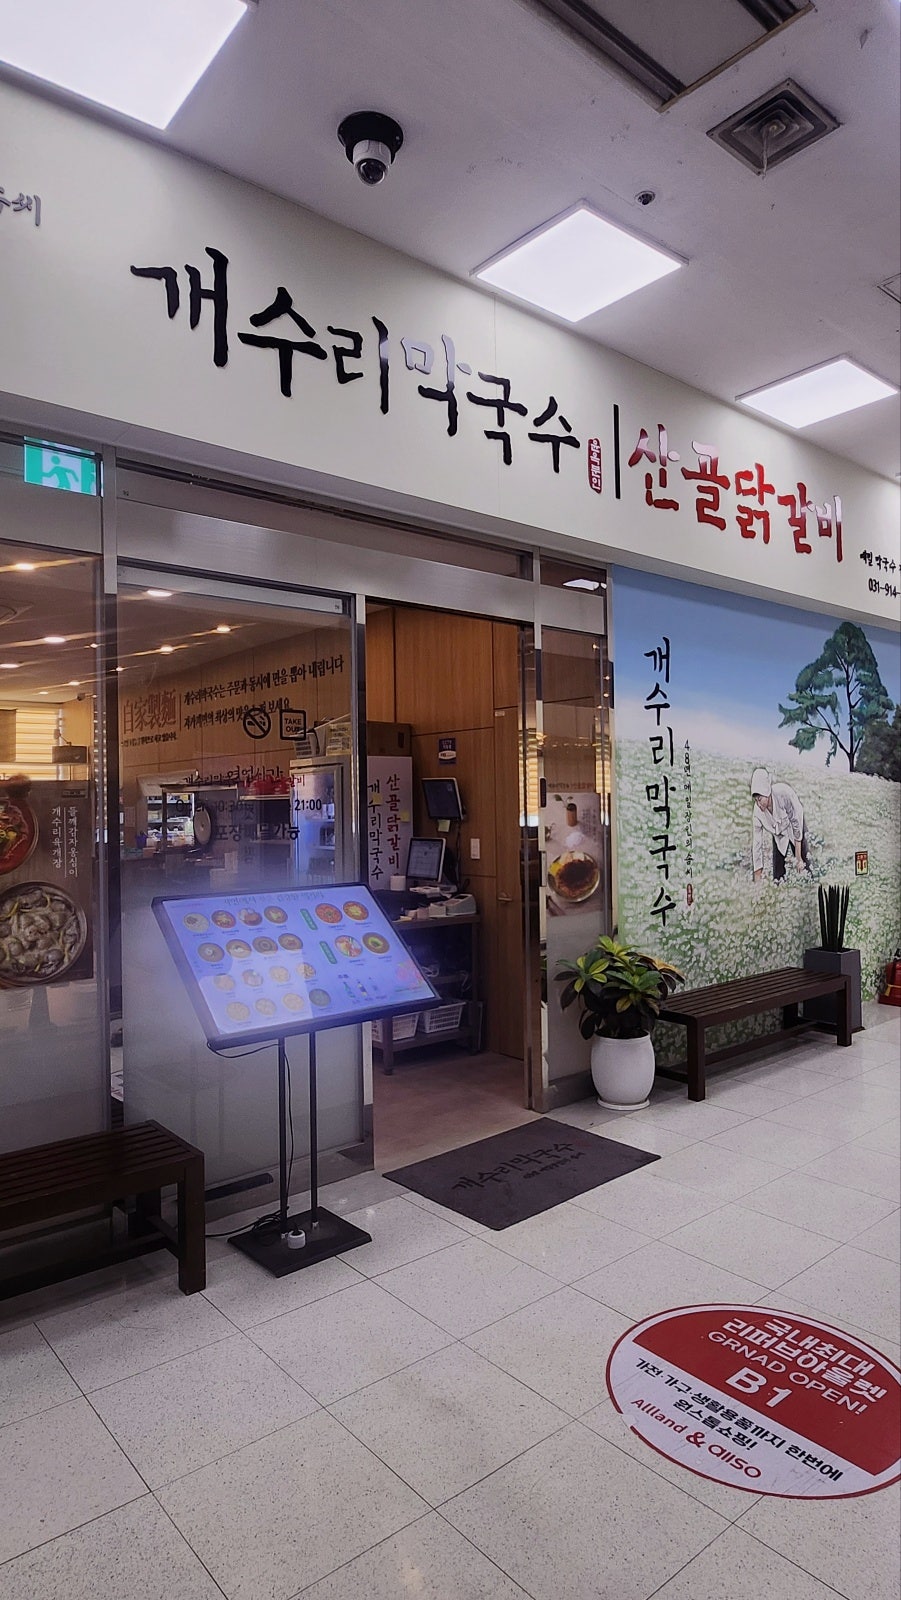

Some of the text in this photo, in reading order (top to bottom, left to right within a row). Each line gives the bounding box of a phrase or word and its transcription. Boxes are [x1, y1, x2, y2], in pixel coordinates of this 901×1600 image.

[130, 246, 581, 473] 개수리막국수
[628, 423, 843, 562] 산골닭갈비
[875, 554, 896, 573] 막국수
[226, 677, 248, 697] 주문과
[249, 673, 271, 692] 동시에
[272, 668, 288, 686] 면을
[290, 664, 307, 684] 뽑아
[308, 655, 344, 679] 내립니다
[285, 726, 301, 734] OUT
[295, 799, 322, 811] 21:00
[644, 636, 677, 927] 개수리막국수
[52, 806, 62, 869] 개수리육개장
[386, 774, 400, 869] 산골닭갈비
[452, 1143, 574, 1190] 개수리막국수
[708, 1331, 868, 1415] GRNAD OPEN!
[722, 1318, 888, 1402] 리퍼브아울렛
[764, 1318, 876, 1377] 국내최대
[630, 1398, 689, 1434] Allland
[685, 1431, 707, 1449] &
[672, 1398, 758, 1451] 원스톱쇼핑!
[784, 1443, 844, 1482] 한번에
